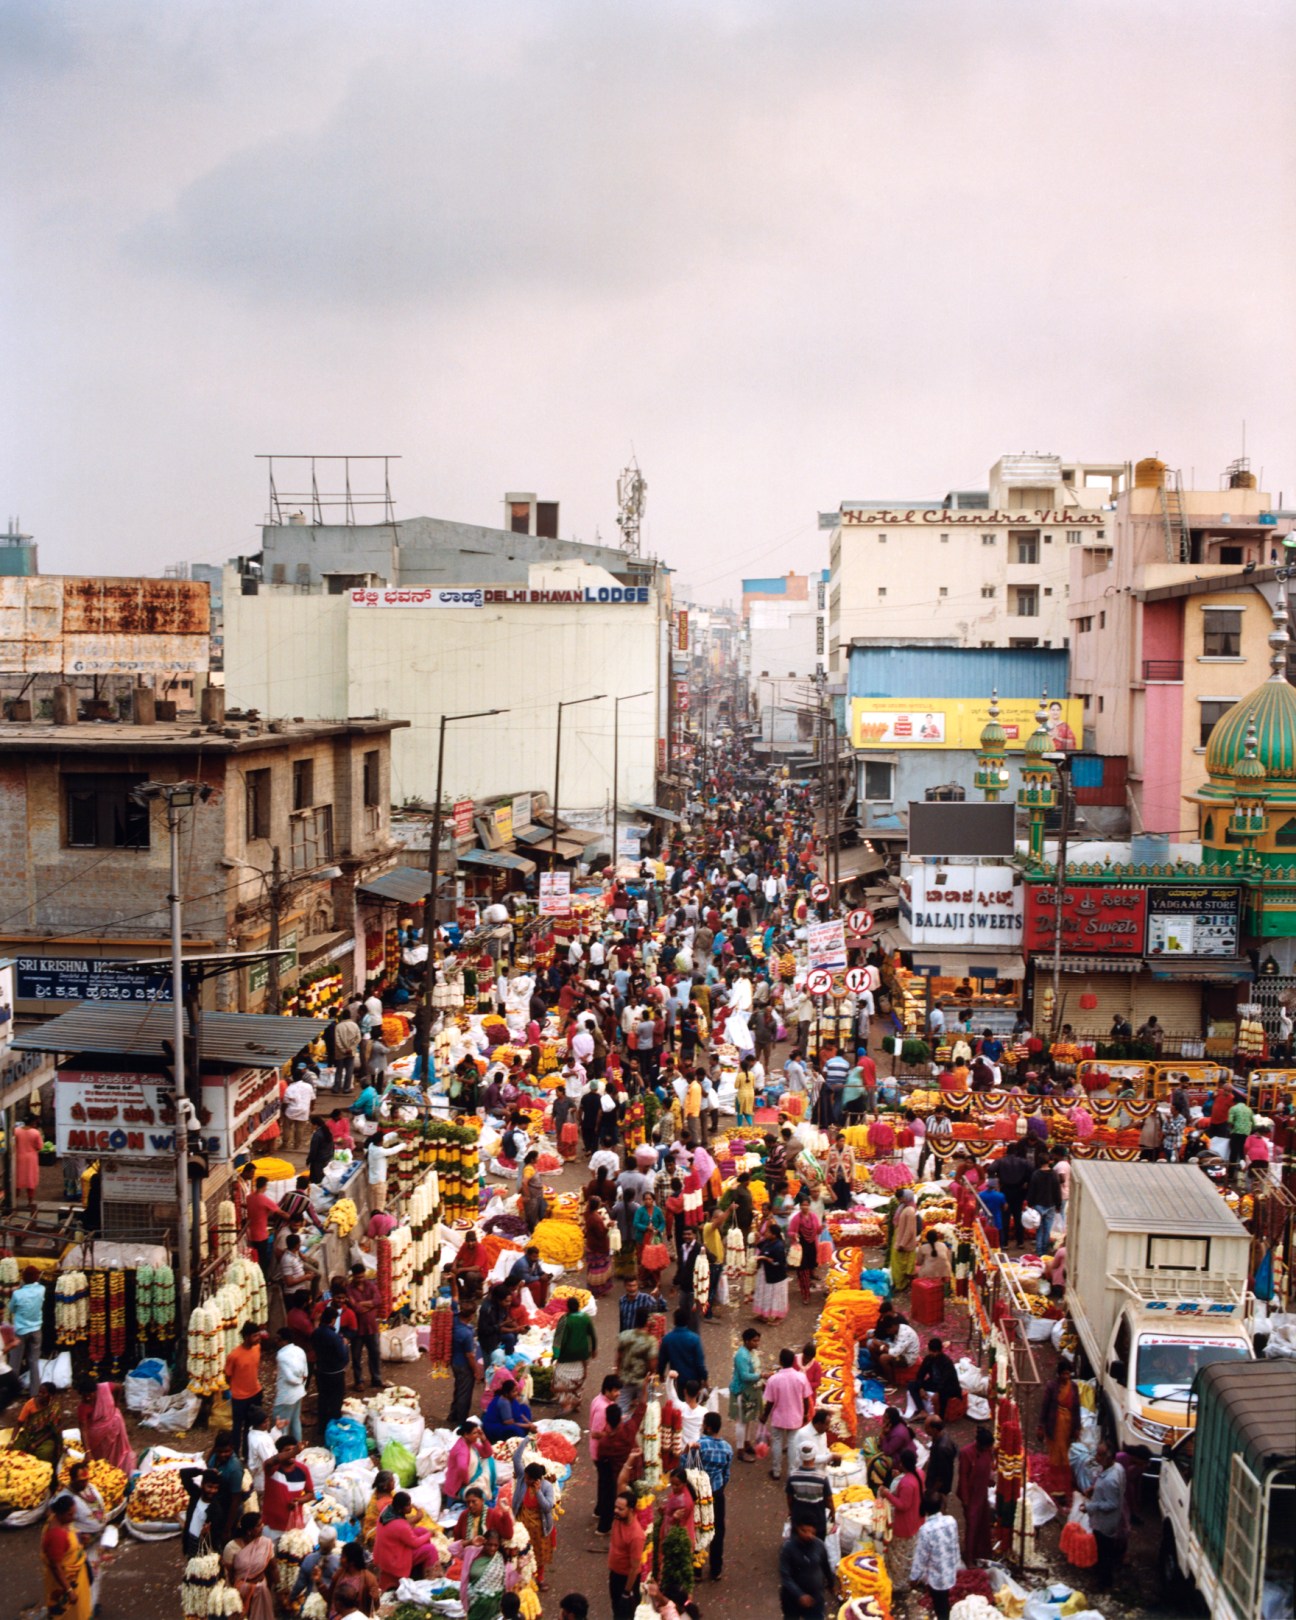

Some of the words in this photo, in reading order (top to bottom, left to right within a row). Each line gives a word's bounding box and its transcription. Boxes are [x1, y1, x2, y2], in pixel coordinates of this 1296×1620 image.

[843, 509, 915, 523] Hotel
[922, 509, 1031, 523] Chandra
[1034, 509, 1104, 523] Vihar
[384, 589, 432, 604] ಭವನ್
[484, 590, 526, 602] DELHI
[530, 590, 583, 602] BHAVAN
[585, 587, 649, 602] LODGE
[1152, 900, 1202, 909] YADGAAR
[1204, 901, 1236, 909] STORE
[915, 913, 965, 930] BALAJI
[969, 913, 1023, 929] SWEETS
[1084, 918, 1138, 934] Sweets
[19, 960, 37, 971] SRI
[40, 961, 88, 972] KRISHNA
[68, 1128, 145, 1150] MICON
